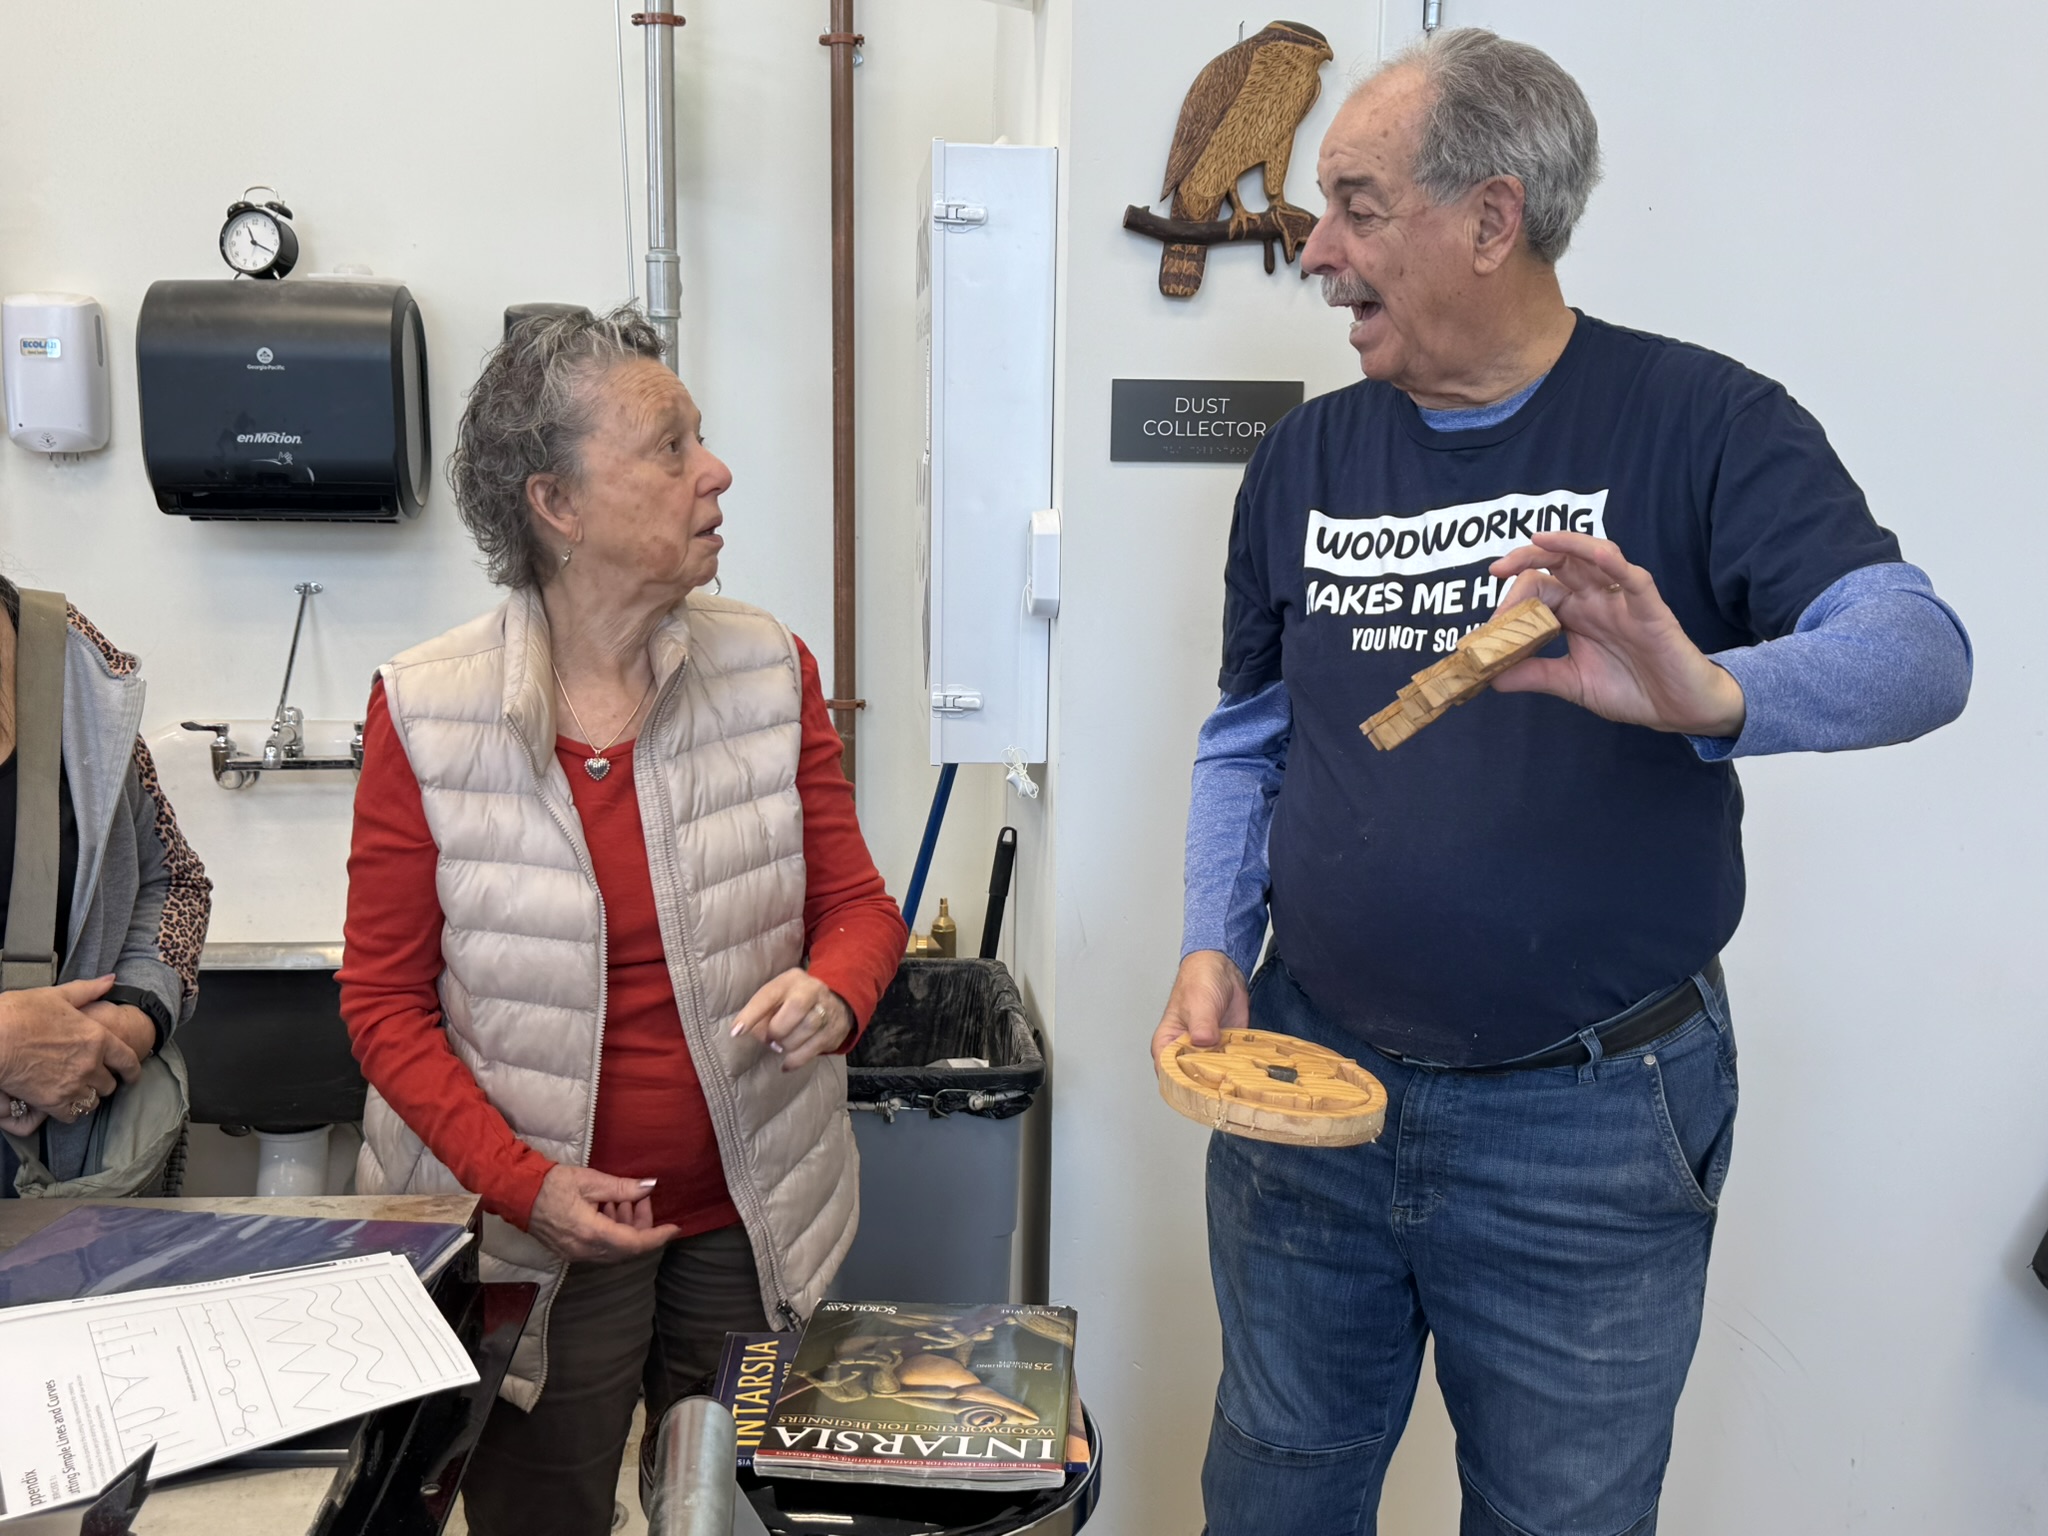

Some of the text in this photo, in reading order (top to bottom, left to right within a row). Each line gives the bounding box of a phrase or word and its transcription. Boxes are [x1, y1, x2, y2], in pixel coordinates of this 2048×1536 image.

[1175, 397, 1230, 414] DUST
[236, 431, 301, 444] enMotion
[1143, 420, 1267, 437] COLLECTOR
[1316, 504, 1594, 560] WOODWORKING
[1411, 579, 1466, 615] ME
[1352, 628, 1387, 651] YOU
[1388, 625, 1428, 650] NOT
[1432, 627, 1459, 653] SO
[1034, 1362, 1053, 1371] 25
[45, 1379, 60, 1407] Curves
[731, 1340, 779, 1446] INTARSIA
[48, 1407, 64, 1423] and
[778, 1415, 1055, 1436] WOODWORKING FOR BEGINNERS
[55, 1424, 71, 1447] Lines
[772, 1426, 1056, 1459] INTARSIA
[57, 1446, 76, 1474] Simple
[21, 1468, 47, 1507] ppendix
